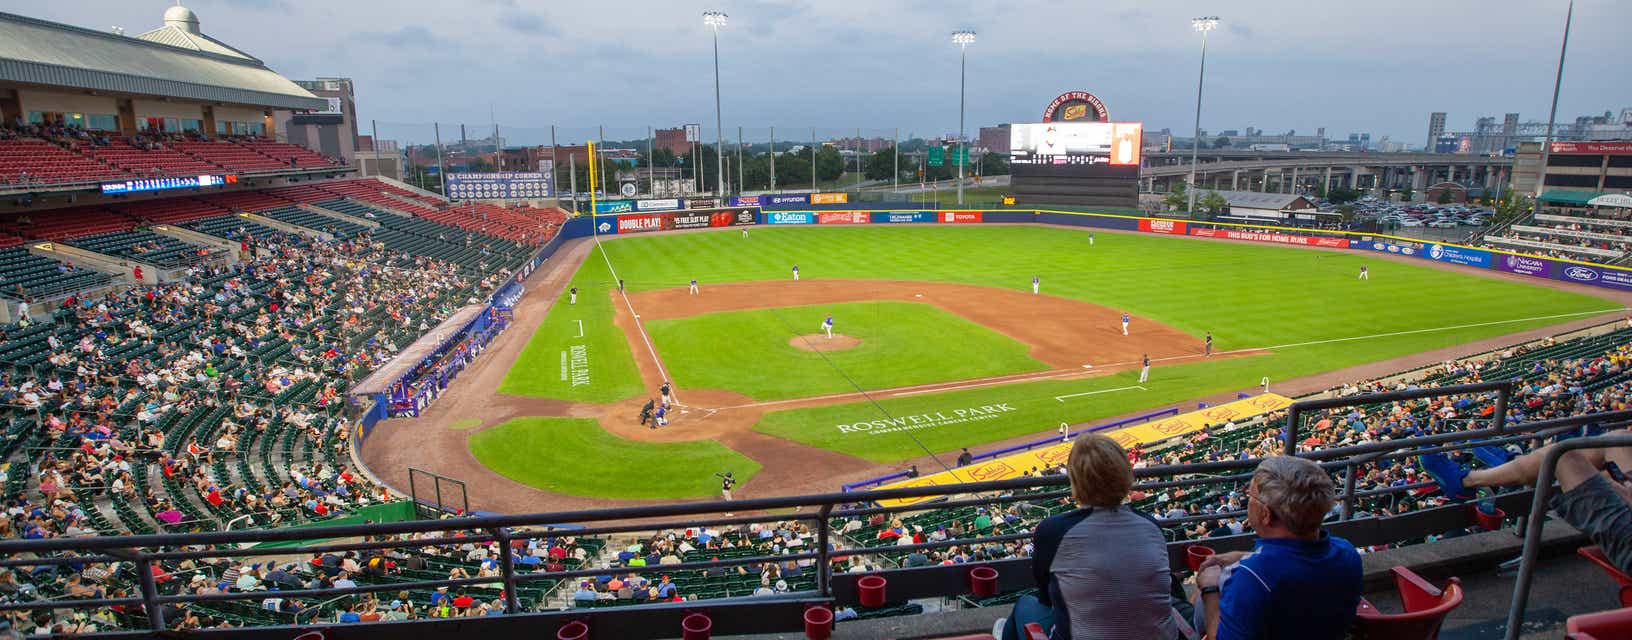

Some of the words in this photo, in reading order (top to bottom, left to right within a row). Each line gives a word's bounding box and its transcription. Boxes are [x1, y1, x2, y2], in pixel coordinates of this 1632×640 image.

[1045, 98, 1061, 118] HOME
[1061, 94, 1070, 102] OF
[457, 172, 513, 180] CHAMPIONSHIP
[700, 216, 709, 224] PLAY
[782, 212, 806, 221] Eaton
[619, 219, 643, 230] DOUBLE
[644, 217, 661, 228] PLAY!
[1227, 231, 1240, 239] THIS
[1241, 232, 1258, 240] BUD'S
[1291, 236, 1307, 244] RUNS
[1516, 262, 1543, 272] UNIVERSITY
[1518, 257, 1543, 267] NIAGARA
[1570, 269, 1592, 277] Ford
[837, 411, 953, 434] ROSWELL
[955, 403, 1016, 420] PARK
[869, 423, 936, 435] COMPREHENSIVE
[938, 417, 968, 426] CANCER
[969, 413, 999, 422] CENTER
